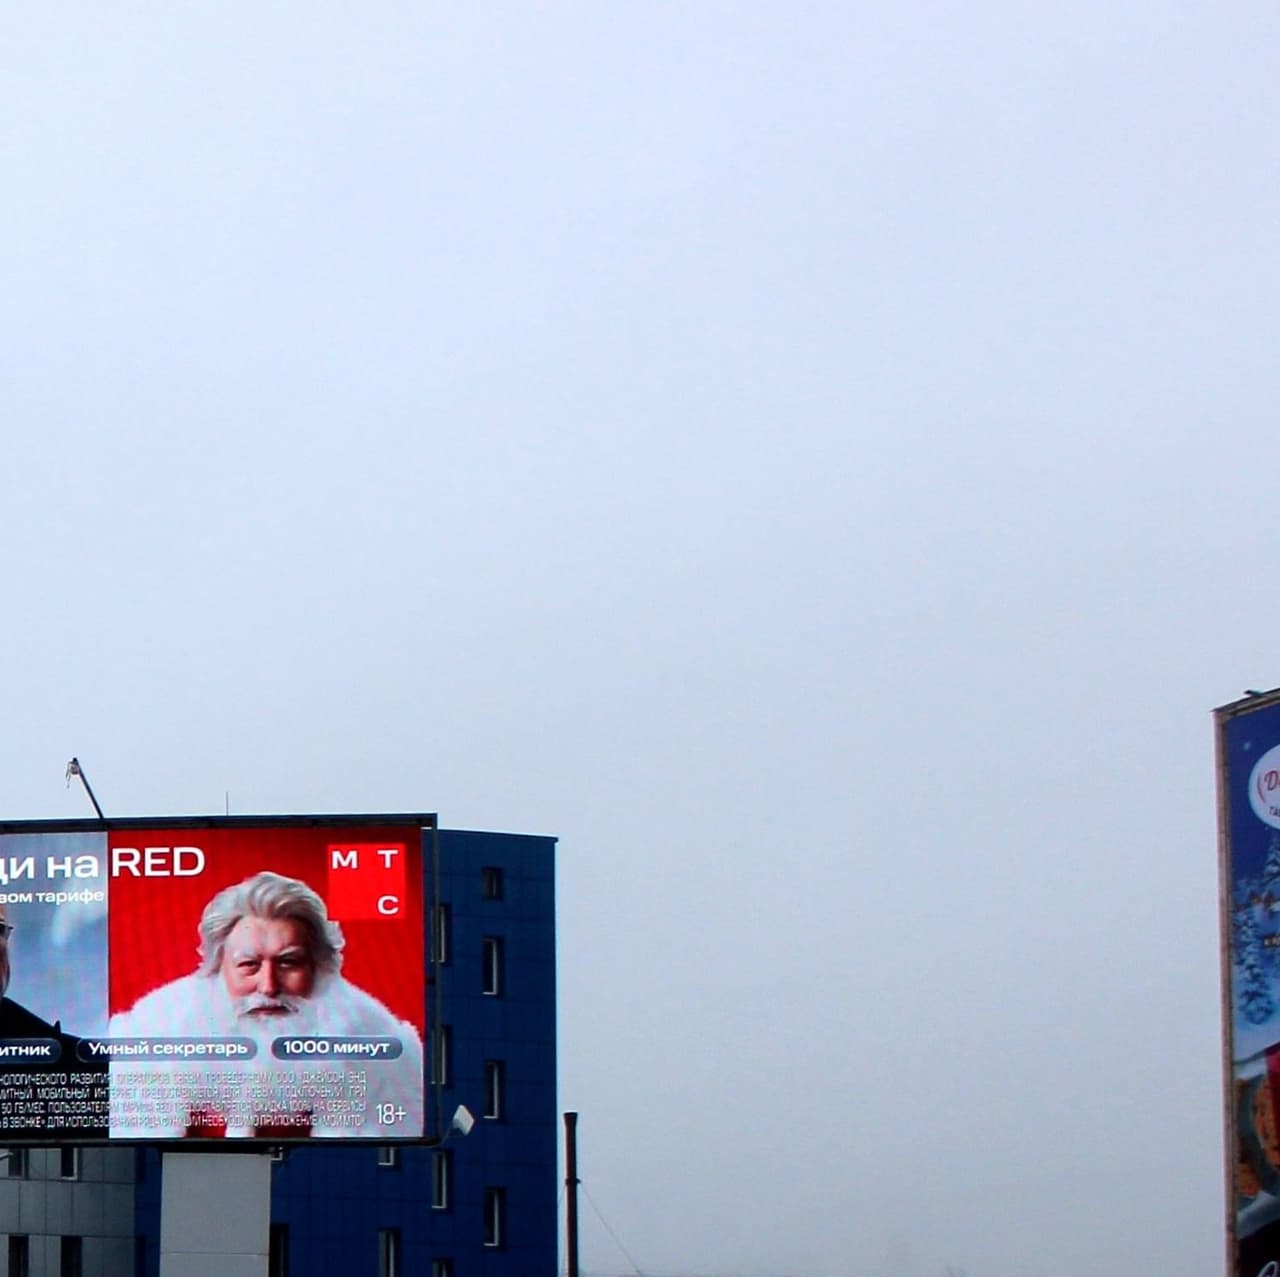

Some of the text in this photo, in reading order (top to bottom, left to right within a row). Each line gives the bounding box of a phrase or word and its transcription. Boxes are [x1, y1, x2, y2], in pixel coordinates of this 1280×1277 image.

[46, 855, 99, 879] на
[112, 847, 205, 877] RED
[35, 888, 105, 906] тарифе
[89, 1041, 248, 1057] Умный секретарь
[283, 1040, 390, 1056] 1000 минут
[36, 1085, 90, 1099] МОБИЛЬНЫЙ
[1, 1102, 13, 1114] 50
[14, 1101, 46, 1114] ГБ/МЕС.
[376, 1103, 407, 1125] 18+
[47, 1115, 65, 1128] ДЛЯ
